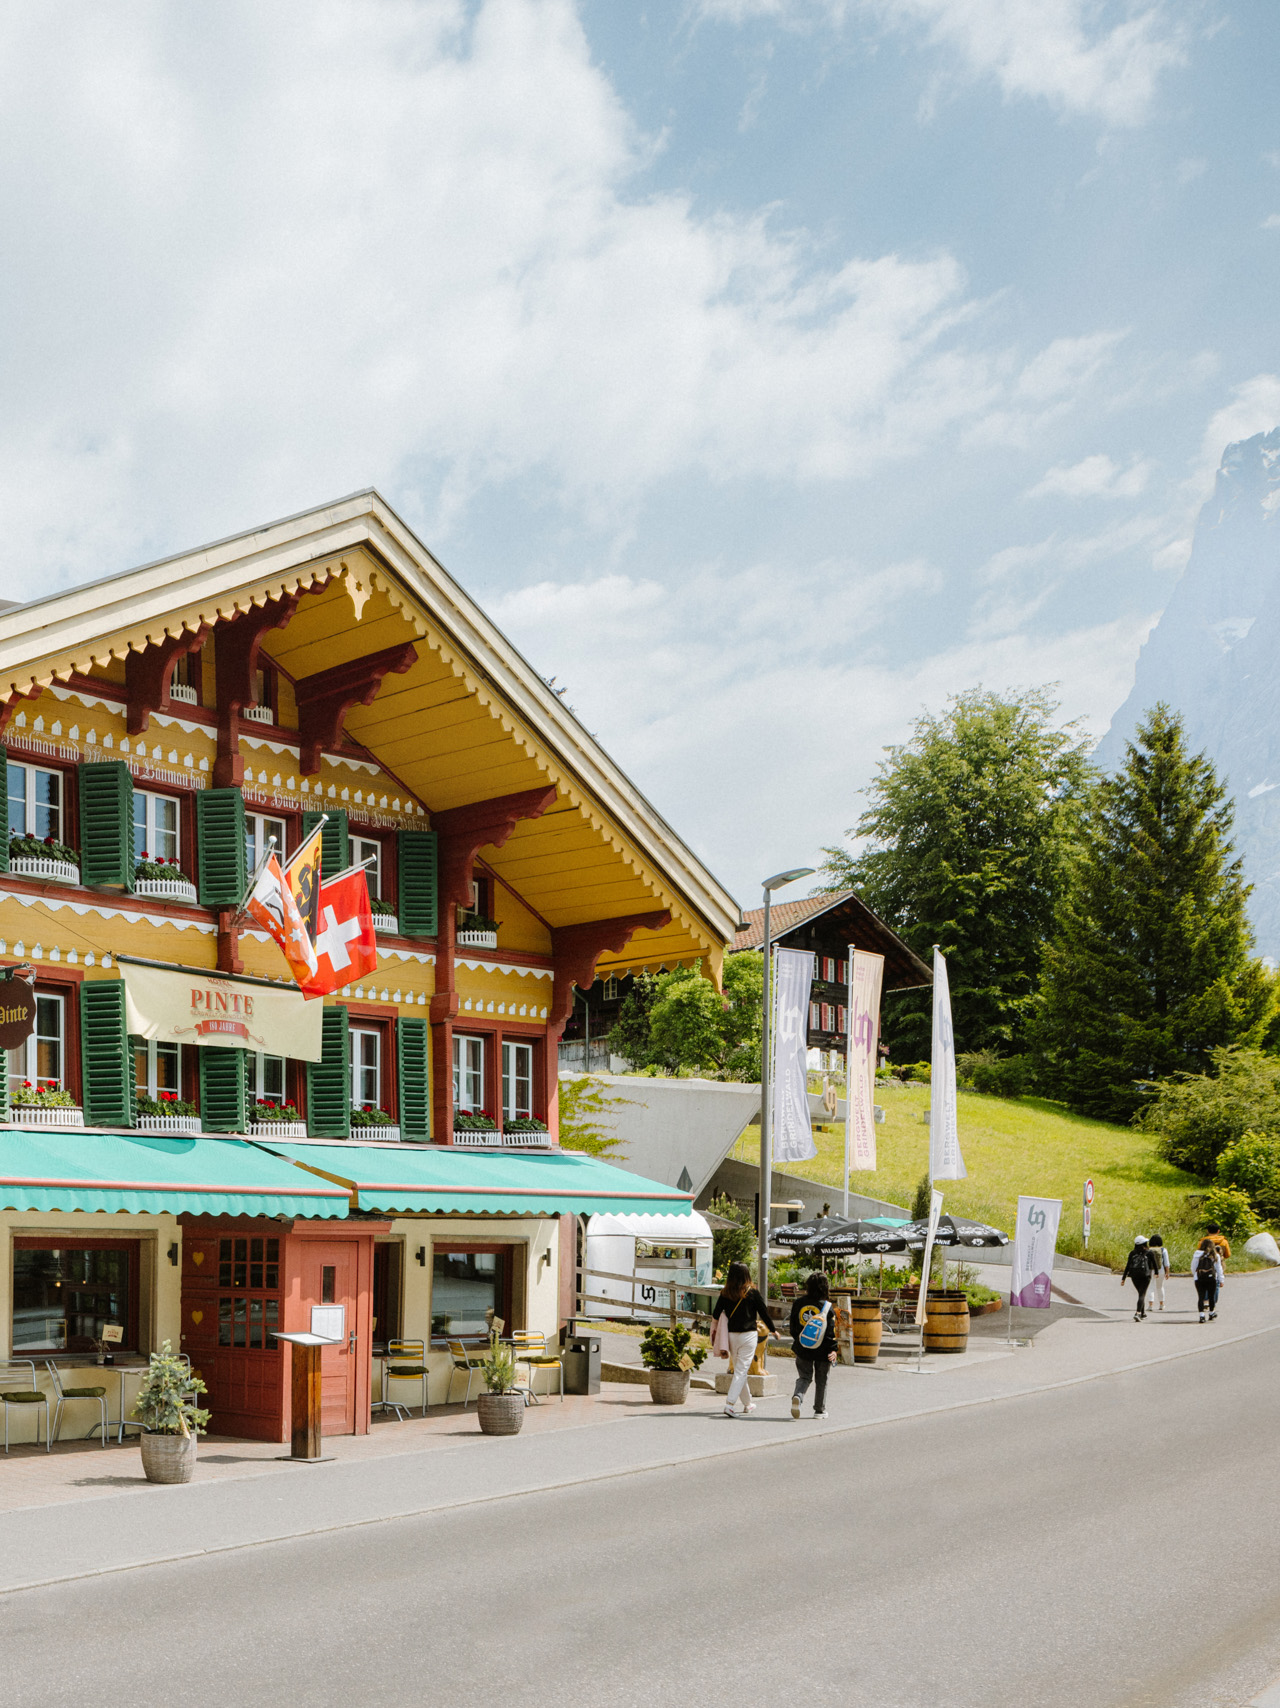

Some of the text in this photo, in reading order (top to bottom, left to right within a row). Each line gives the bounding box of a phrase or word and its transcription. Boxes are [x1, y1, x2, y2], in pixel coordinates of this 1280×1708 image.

[190, 989, 253, 1015] PINTE
[219, 1021, 236, 1033] JAHRE
[821, 1246, 855, 1254] VALAISANNE
